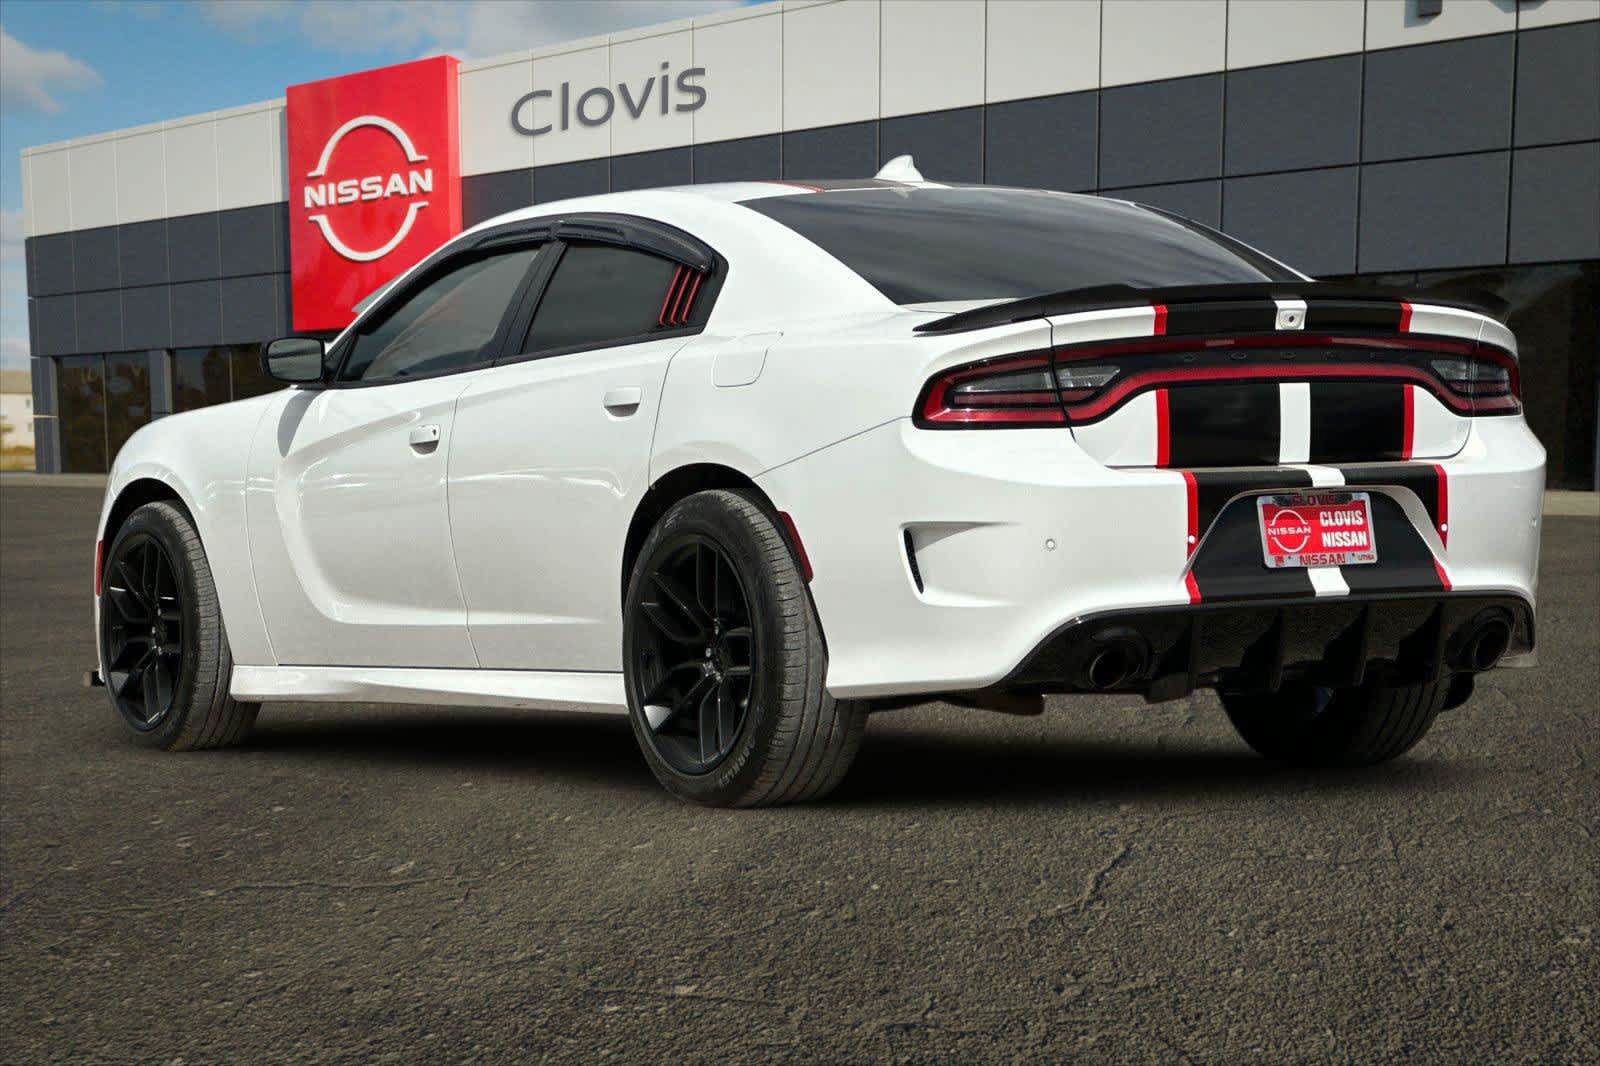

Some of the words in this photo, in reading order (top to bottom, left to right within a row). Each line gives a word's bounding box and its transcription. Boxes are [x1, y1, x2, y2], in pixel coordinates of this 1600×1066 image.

[511, 61, 707, 136] Clovis
[304, 168, 432, 208] NISSAN
[1319, 510, 1363, 527] CLOVIS
[1267, 526, 1312, 536] NISSAN
[1321, 531, 1367, 548] NISSAN
[1300, 553, 1346, 566] NISSAN
